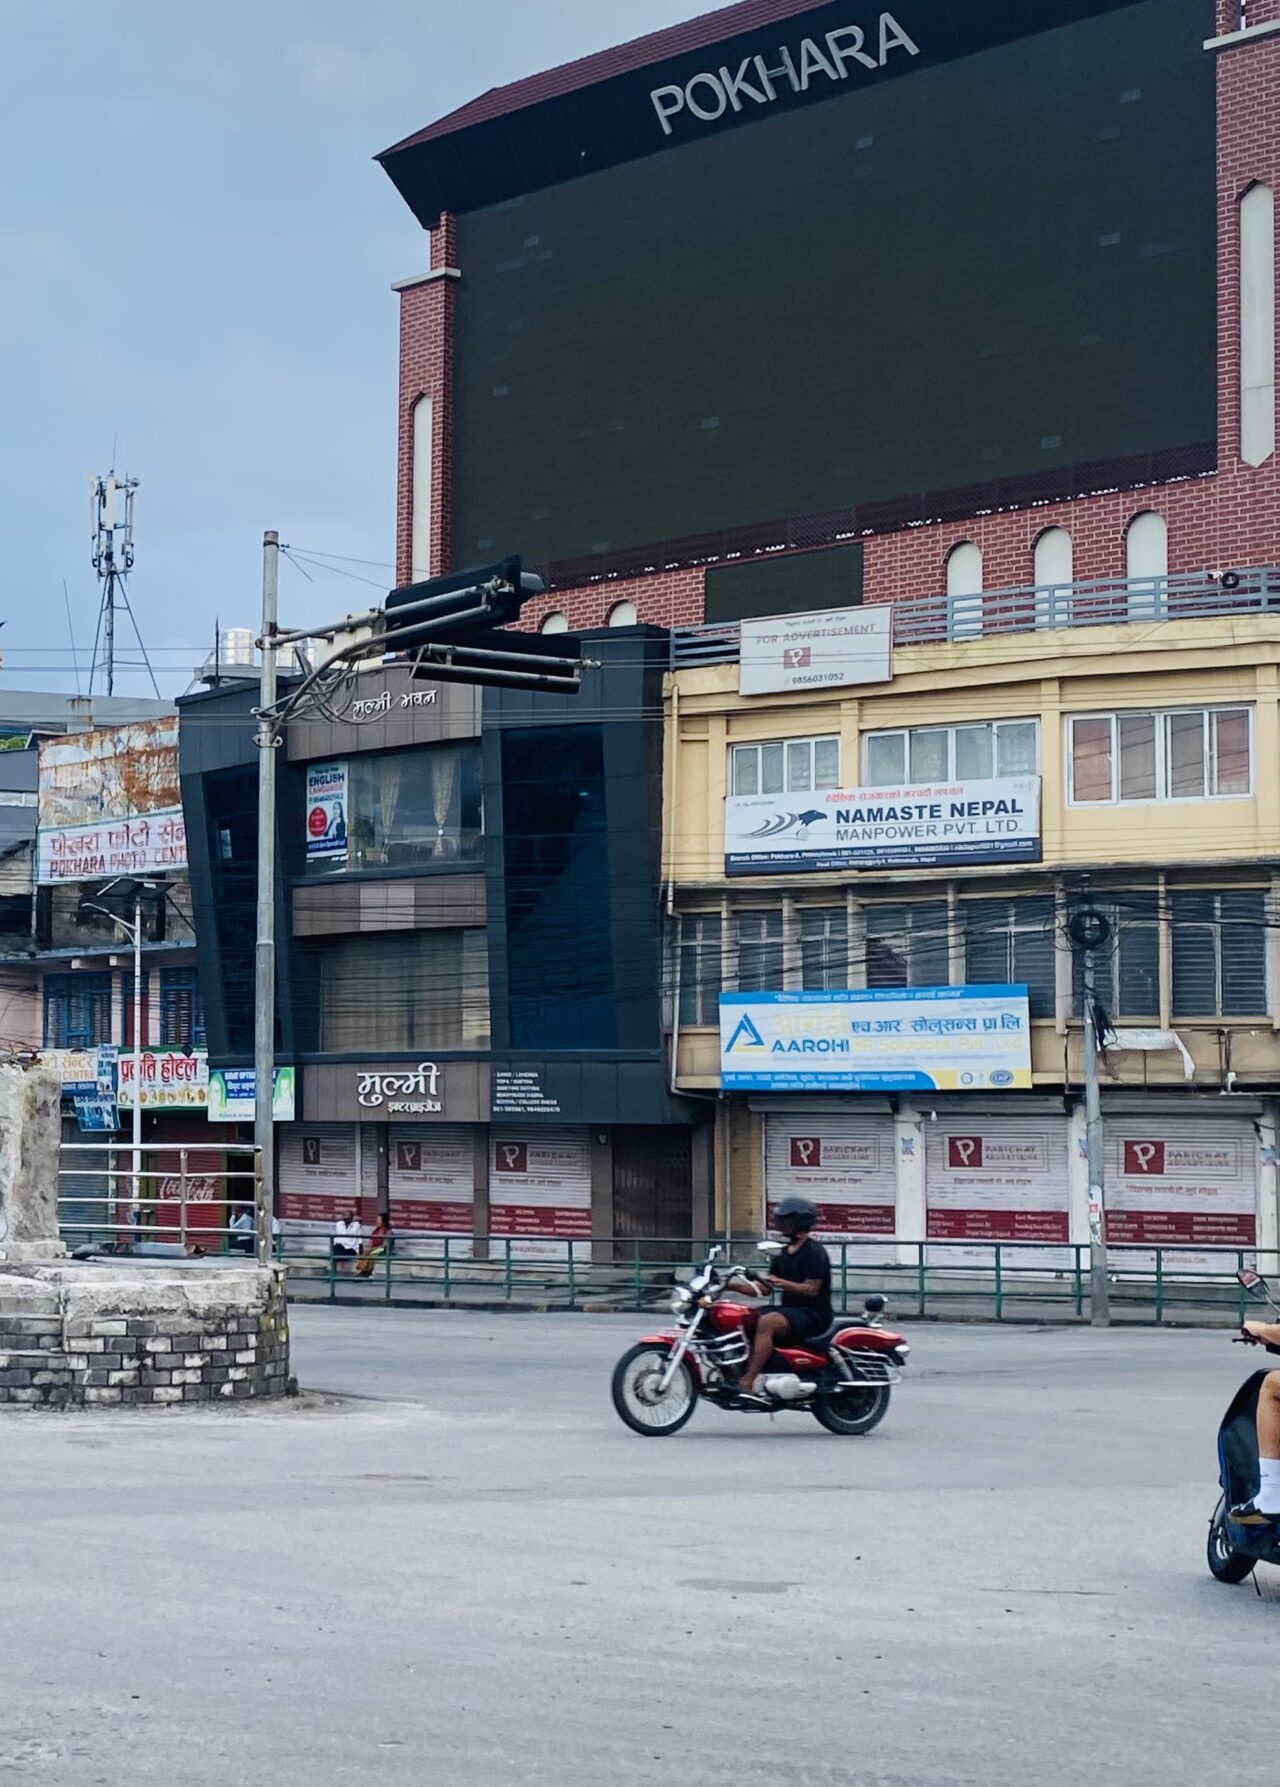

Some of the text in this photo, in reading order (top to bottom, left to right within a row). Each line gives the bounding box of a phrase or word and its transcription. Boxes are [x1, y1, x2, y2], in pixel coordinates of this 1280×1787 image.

[650, 13, 920, 135] POKHARA
[756, 623, 876, 645] FOR ADVERTISEMENT
[792, 672, 844, 685] 9856031052
[308, 773, 345, 787] ENGLISH
[836, 799, 1024, 824] NAMASTE NEPAL
[836, 820, 1023, 841] MANPOWER PVT. LTD.
[49, 854, 106, 879] POKHARA
[110, 849, 147, 871] PHOTO
[771, 1039, 850, 1053] AAROHI
[63, 1070, 96, 1081] CENTRE
[161, 1053, 198, 1083] होटल
[357, 1062, 440, 1107] मुल्मी
